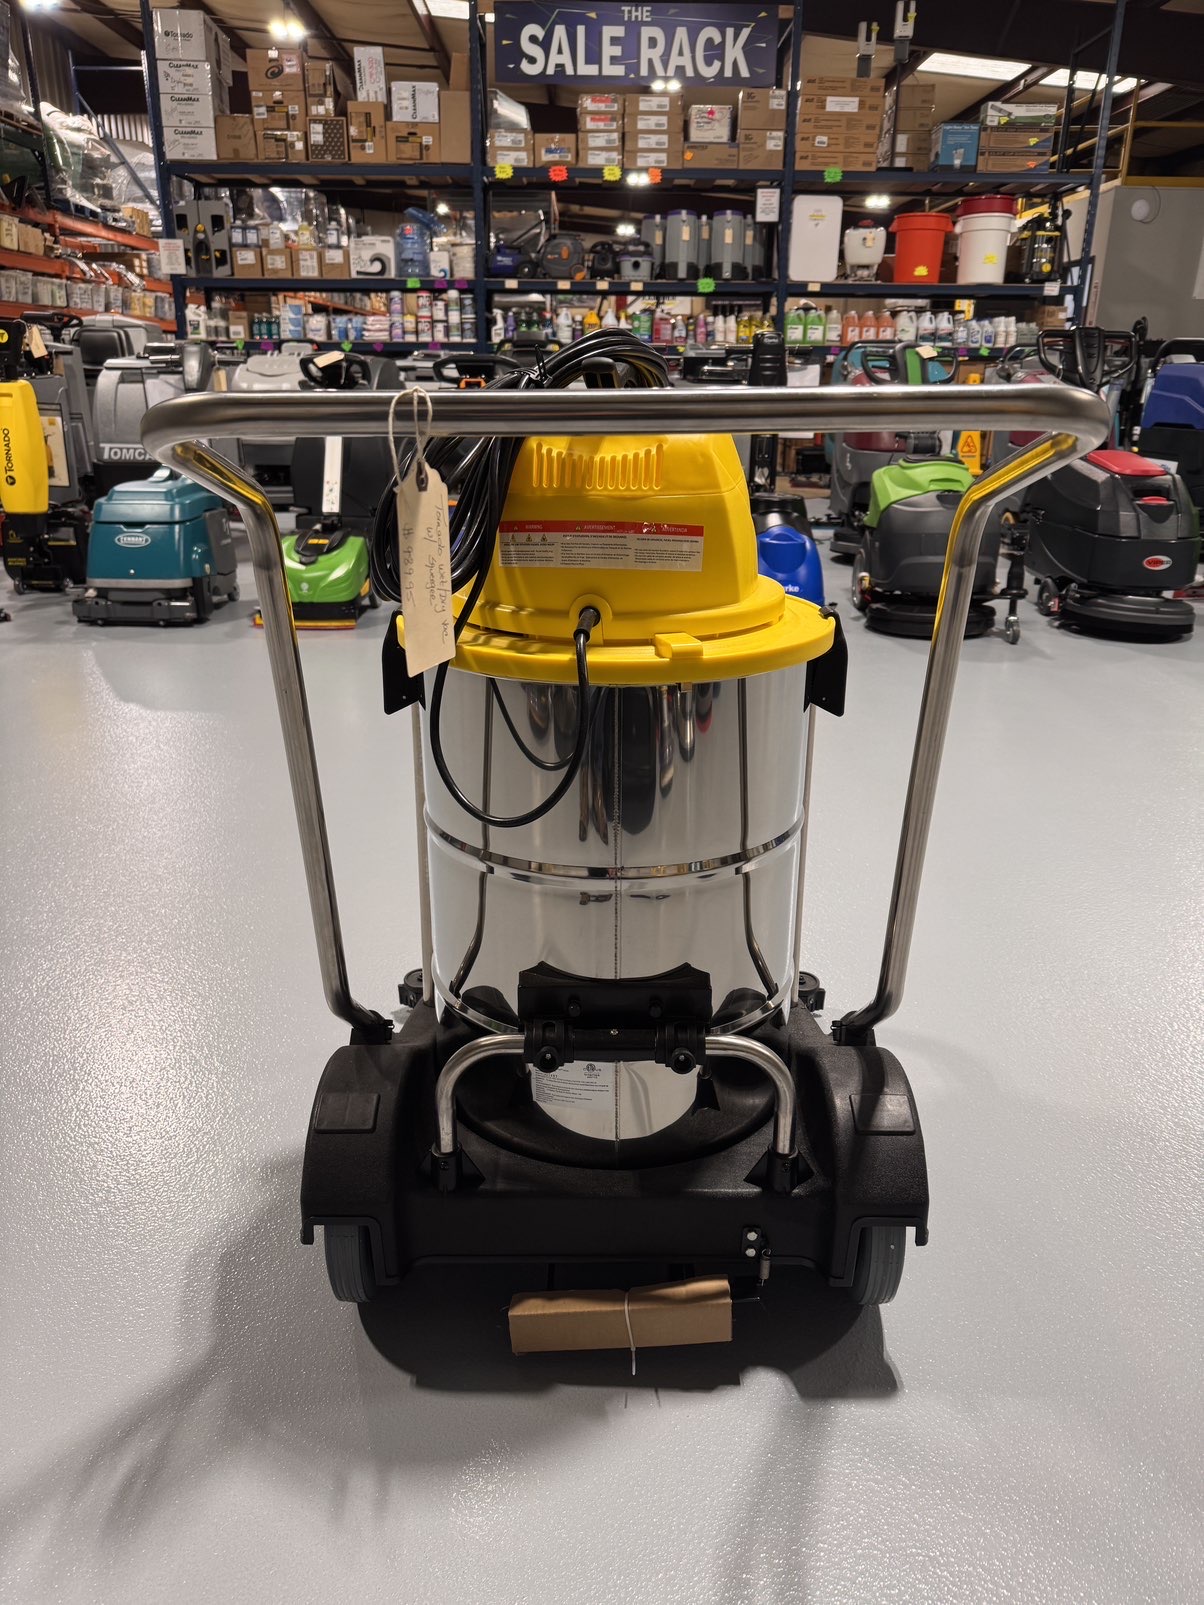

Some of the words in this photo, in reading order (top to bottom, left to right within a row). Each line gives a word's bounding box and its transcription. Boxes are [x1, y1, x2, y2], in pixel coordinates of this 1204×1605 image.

[621, 6, 652, 22] THE
[520, 23, 626, 76] SALE
[640, 26, 751, 78] RACK
[3, 428, 14, 474] TORNADO
[99, 443, 156, 460] TOMCA
[785, 584, 800, 593] rke
